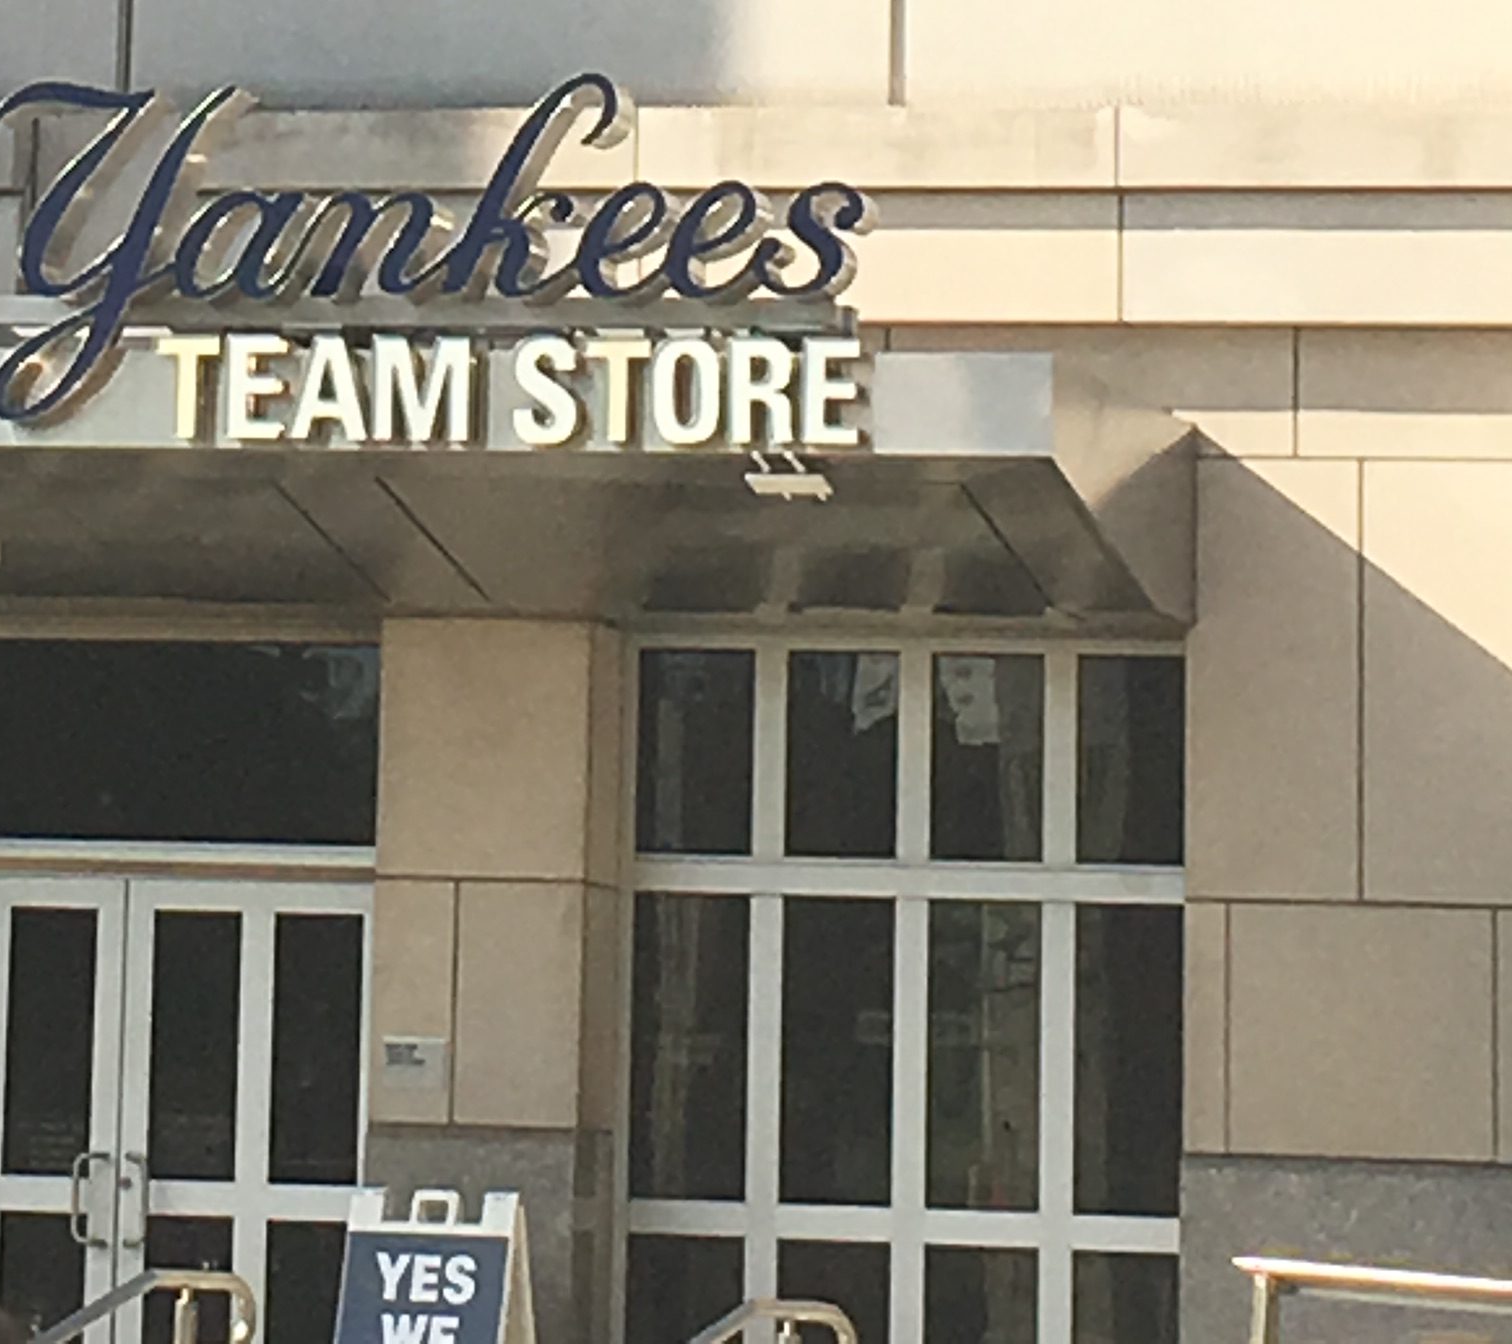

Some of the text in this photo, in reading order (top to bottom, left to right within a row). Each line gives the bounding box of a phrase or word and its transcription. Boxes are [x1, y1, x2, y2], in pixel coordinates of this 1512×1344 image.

[157, 333, 862, 445] TEAM STORE
[375, 1251, 479, 1305] YES
[380, 1313, 460, 1344] WE
